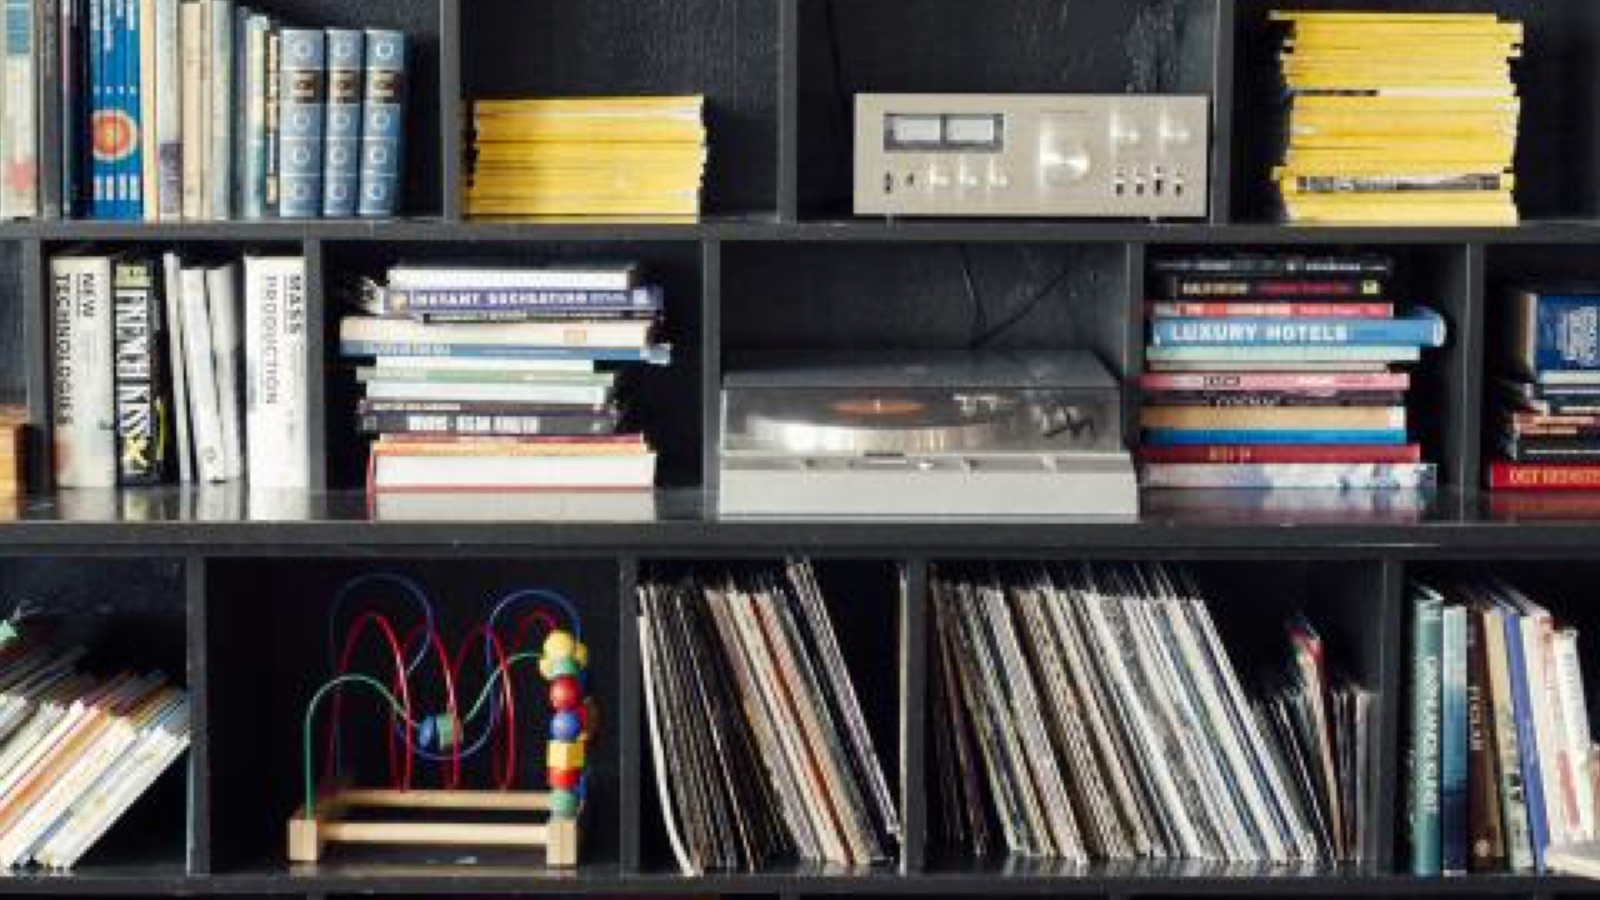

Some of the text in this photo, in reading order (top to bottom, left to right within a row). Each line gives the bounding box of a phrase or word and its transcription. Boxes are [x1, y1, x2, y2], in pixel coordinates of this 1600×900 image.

[82, 272, 95, 318] NEW
[289, 275, 304, 334] MASS
[56, 272, 74, 425] TECHNOLOGIES
[264, 275, 279, 404] PRODUCTION
[1172, 321, 1348, 341] LUXURY HOTELS
